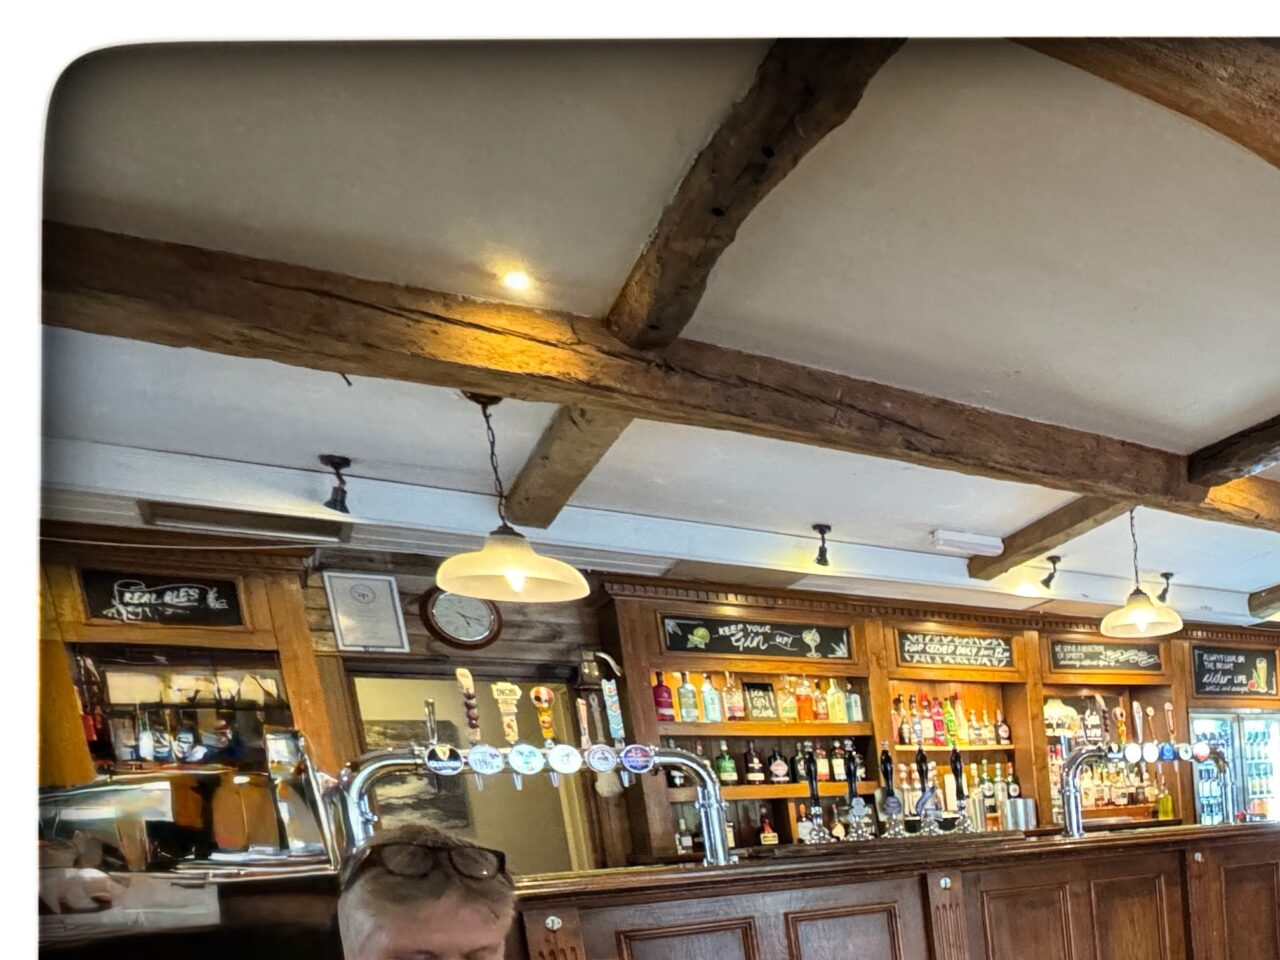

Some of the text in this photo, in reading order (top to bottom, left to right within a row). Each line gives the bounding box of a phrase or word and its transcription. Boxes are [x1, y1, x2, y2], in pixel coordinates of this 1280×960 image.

[123, 588, 200, 604] REAL ALES
[718, 624, 772, 636] KEEP YOUR
[731, 632, 769, 652] Gin
[1203, 653, 1224, 662] ALWAYS
[1224, 655, 1237, 663] LOOK
[1203, 661, 1215, 670] THE
[1233, 675, 1247, 684] LIFE
